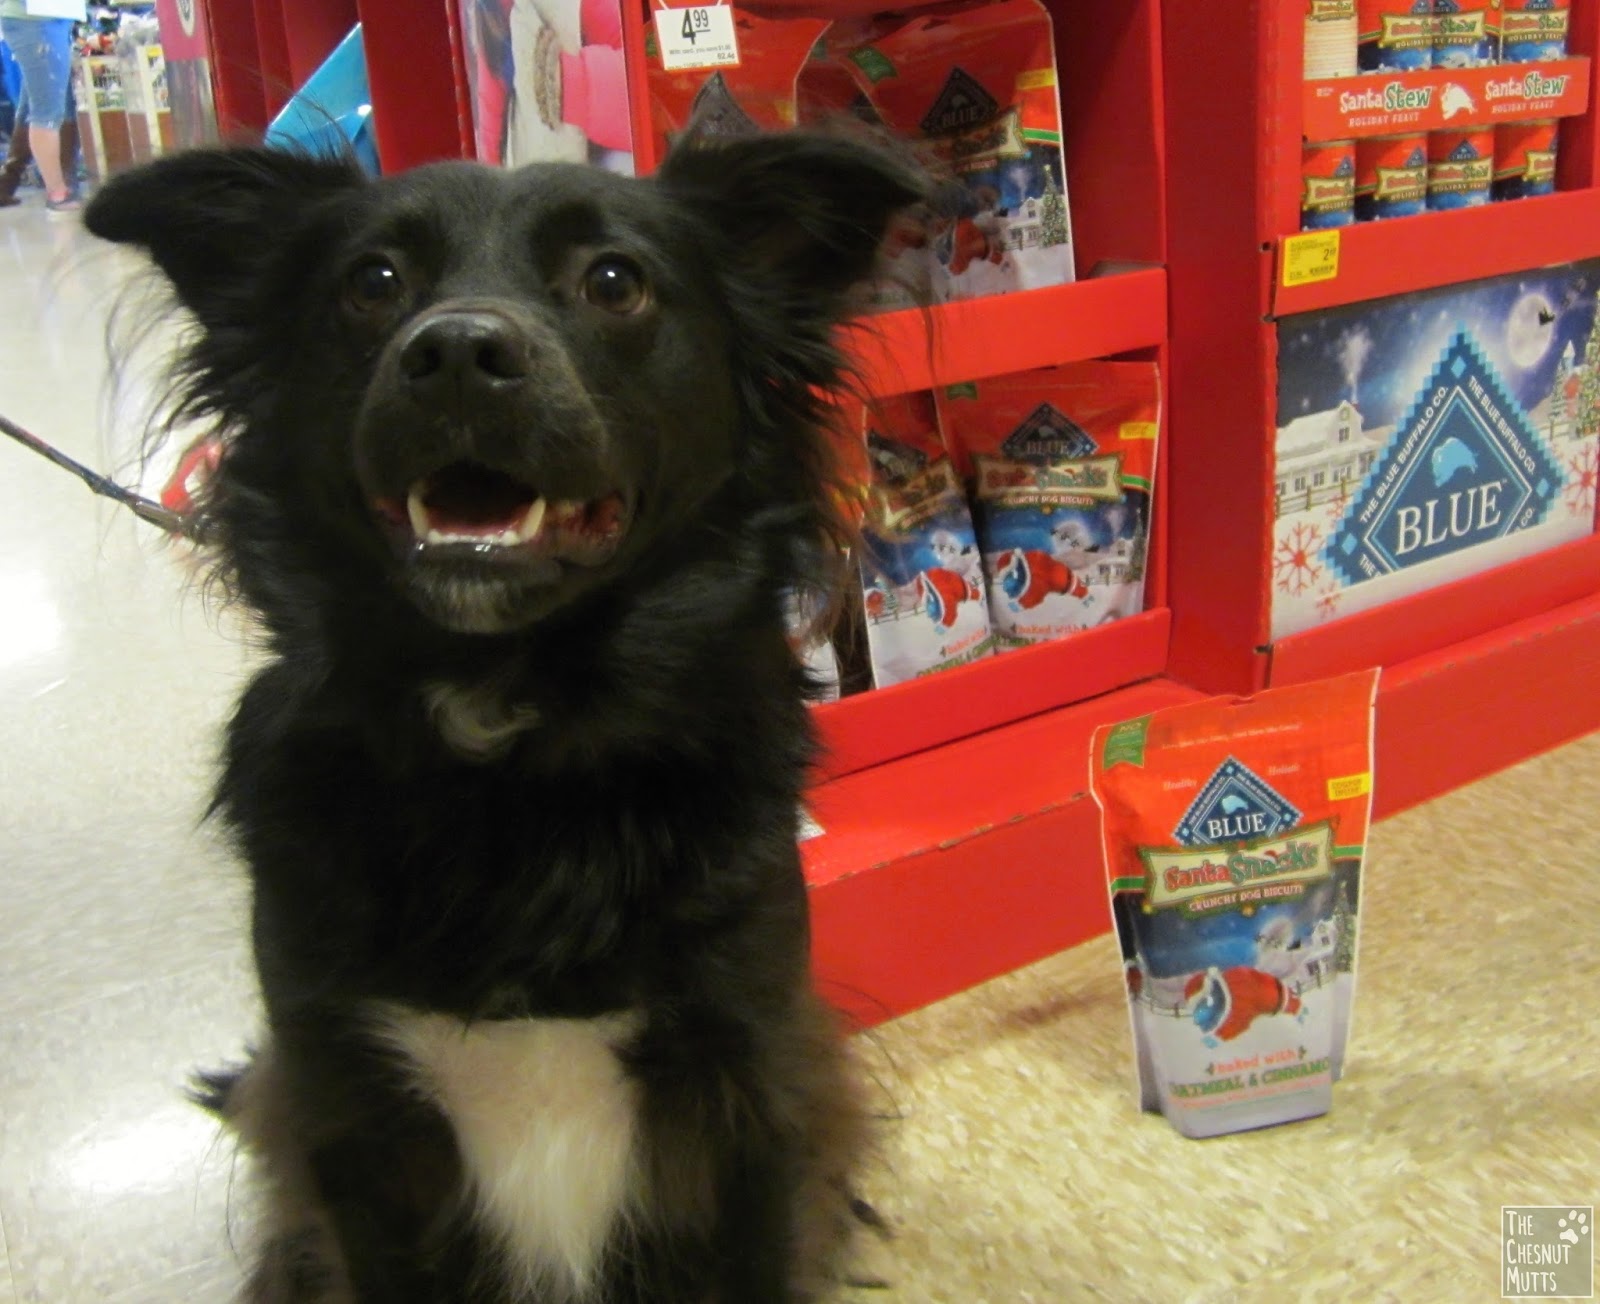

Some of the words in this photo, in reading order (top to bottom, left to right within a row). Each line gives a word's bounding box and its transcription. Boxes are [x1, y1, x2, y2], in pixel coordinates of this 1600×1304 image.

[1349, 115, 1389, 128] HOLIDAY
[1392, 111, 1419, 124] FEAST
[1492, 102, 1527, 114] HOLIDAY
[1468, 375, 1484, 400] THE
[1480, 394, 1501, 424] BLUE
[1498, 415, 1527, 461] BUFFALO
[1360, 498, 1379, 524] THE
[1377, 463, 1400, 497] BLUE
[1398, 408, 1434, 464] BUFFALO
[1395, 480, 1503, 556] BLUE
[1359, 553, 1378, 577] THE
[1207, 813, 1268, 839] BLUE
[1189, 894, 1237, 912] CRUNCHY
[1240, 890, 1261, 901] DOG
[1263, 884, 1304, 897] BISCUITS
[1264, 1048, 1297, 1065] with
